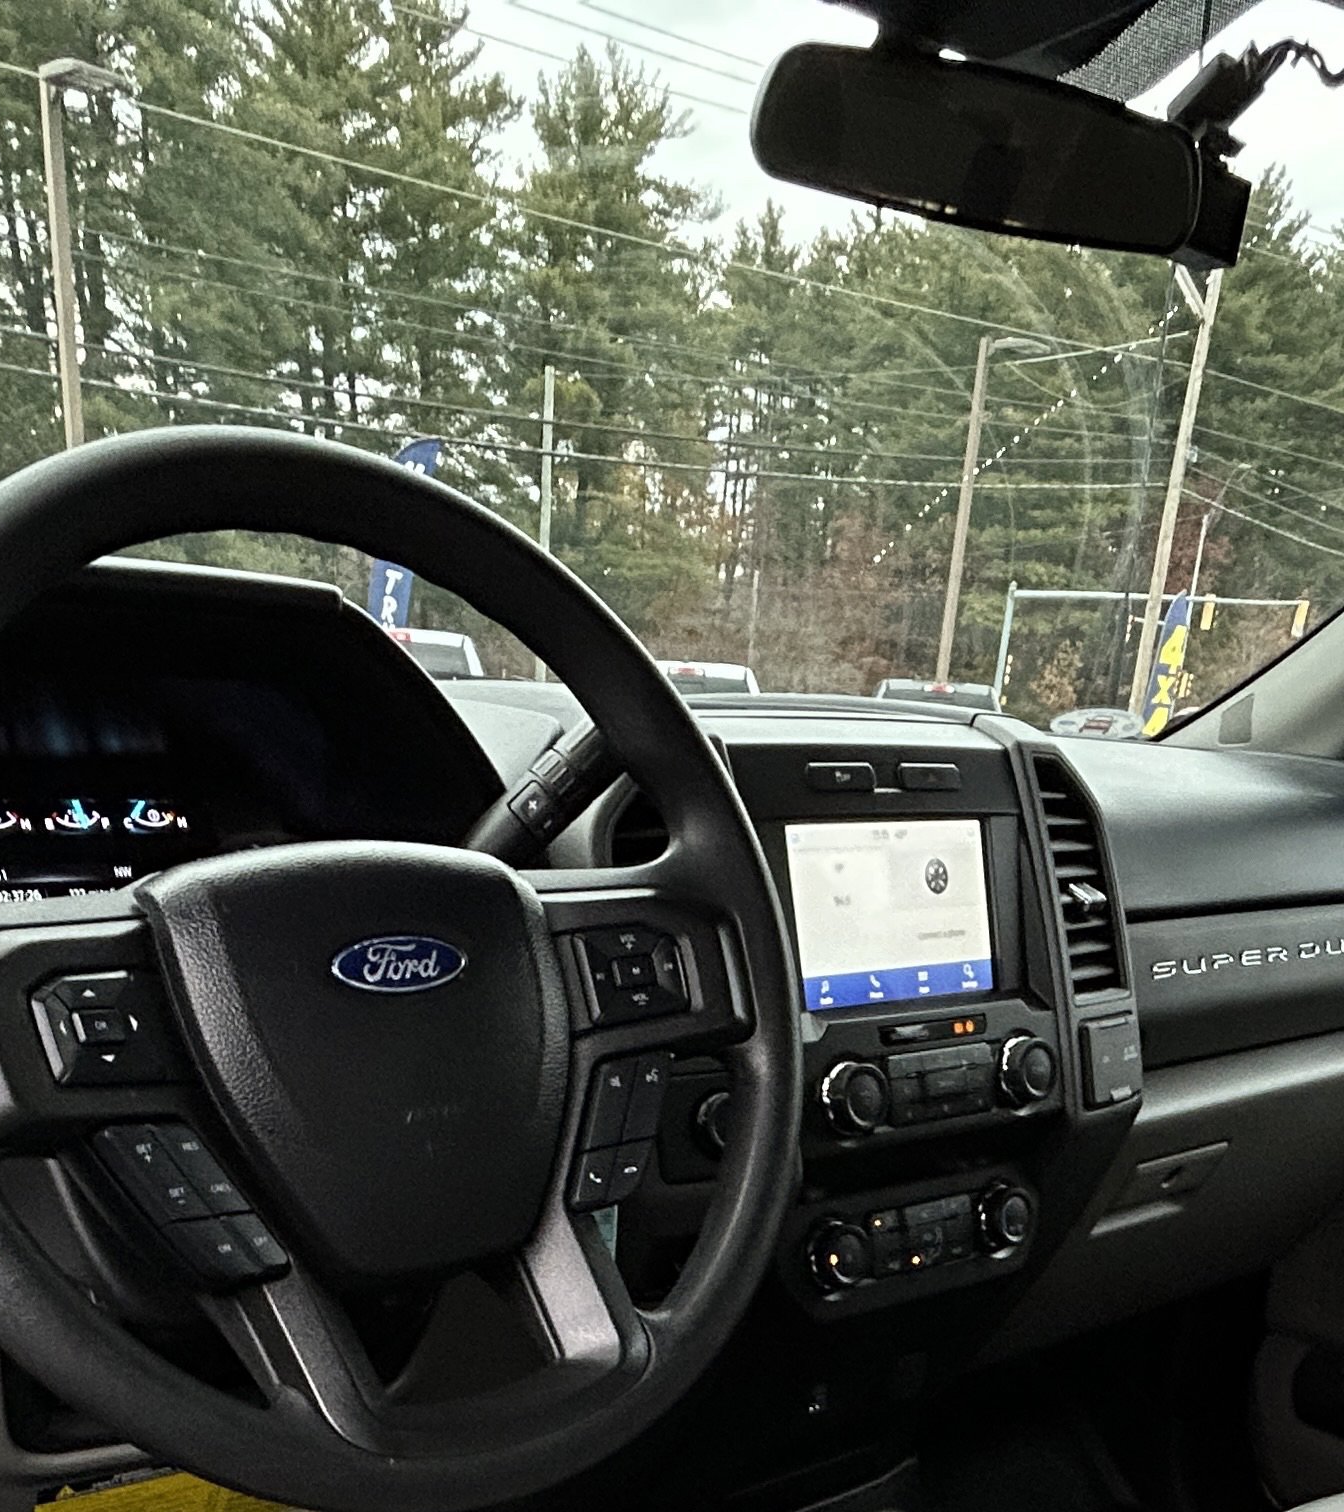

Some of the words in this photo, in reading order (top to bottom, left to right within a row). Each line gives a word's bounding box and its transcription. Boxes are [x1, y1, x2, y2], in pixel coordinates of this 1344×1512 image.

[113, 866, 132, 879] NW
[363, 943, 441, 983] Ford
[1152, 946, 1288, 980] SUPER
